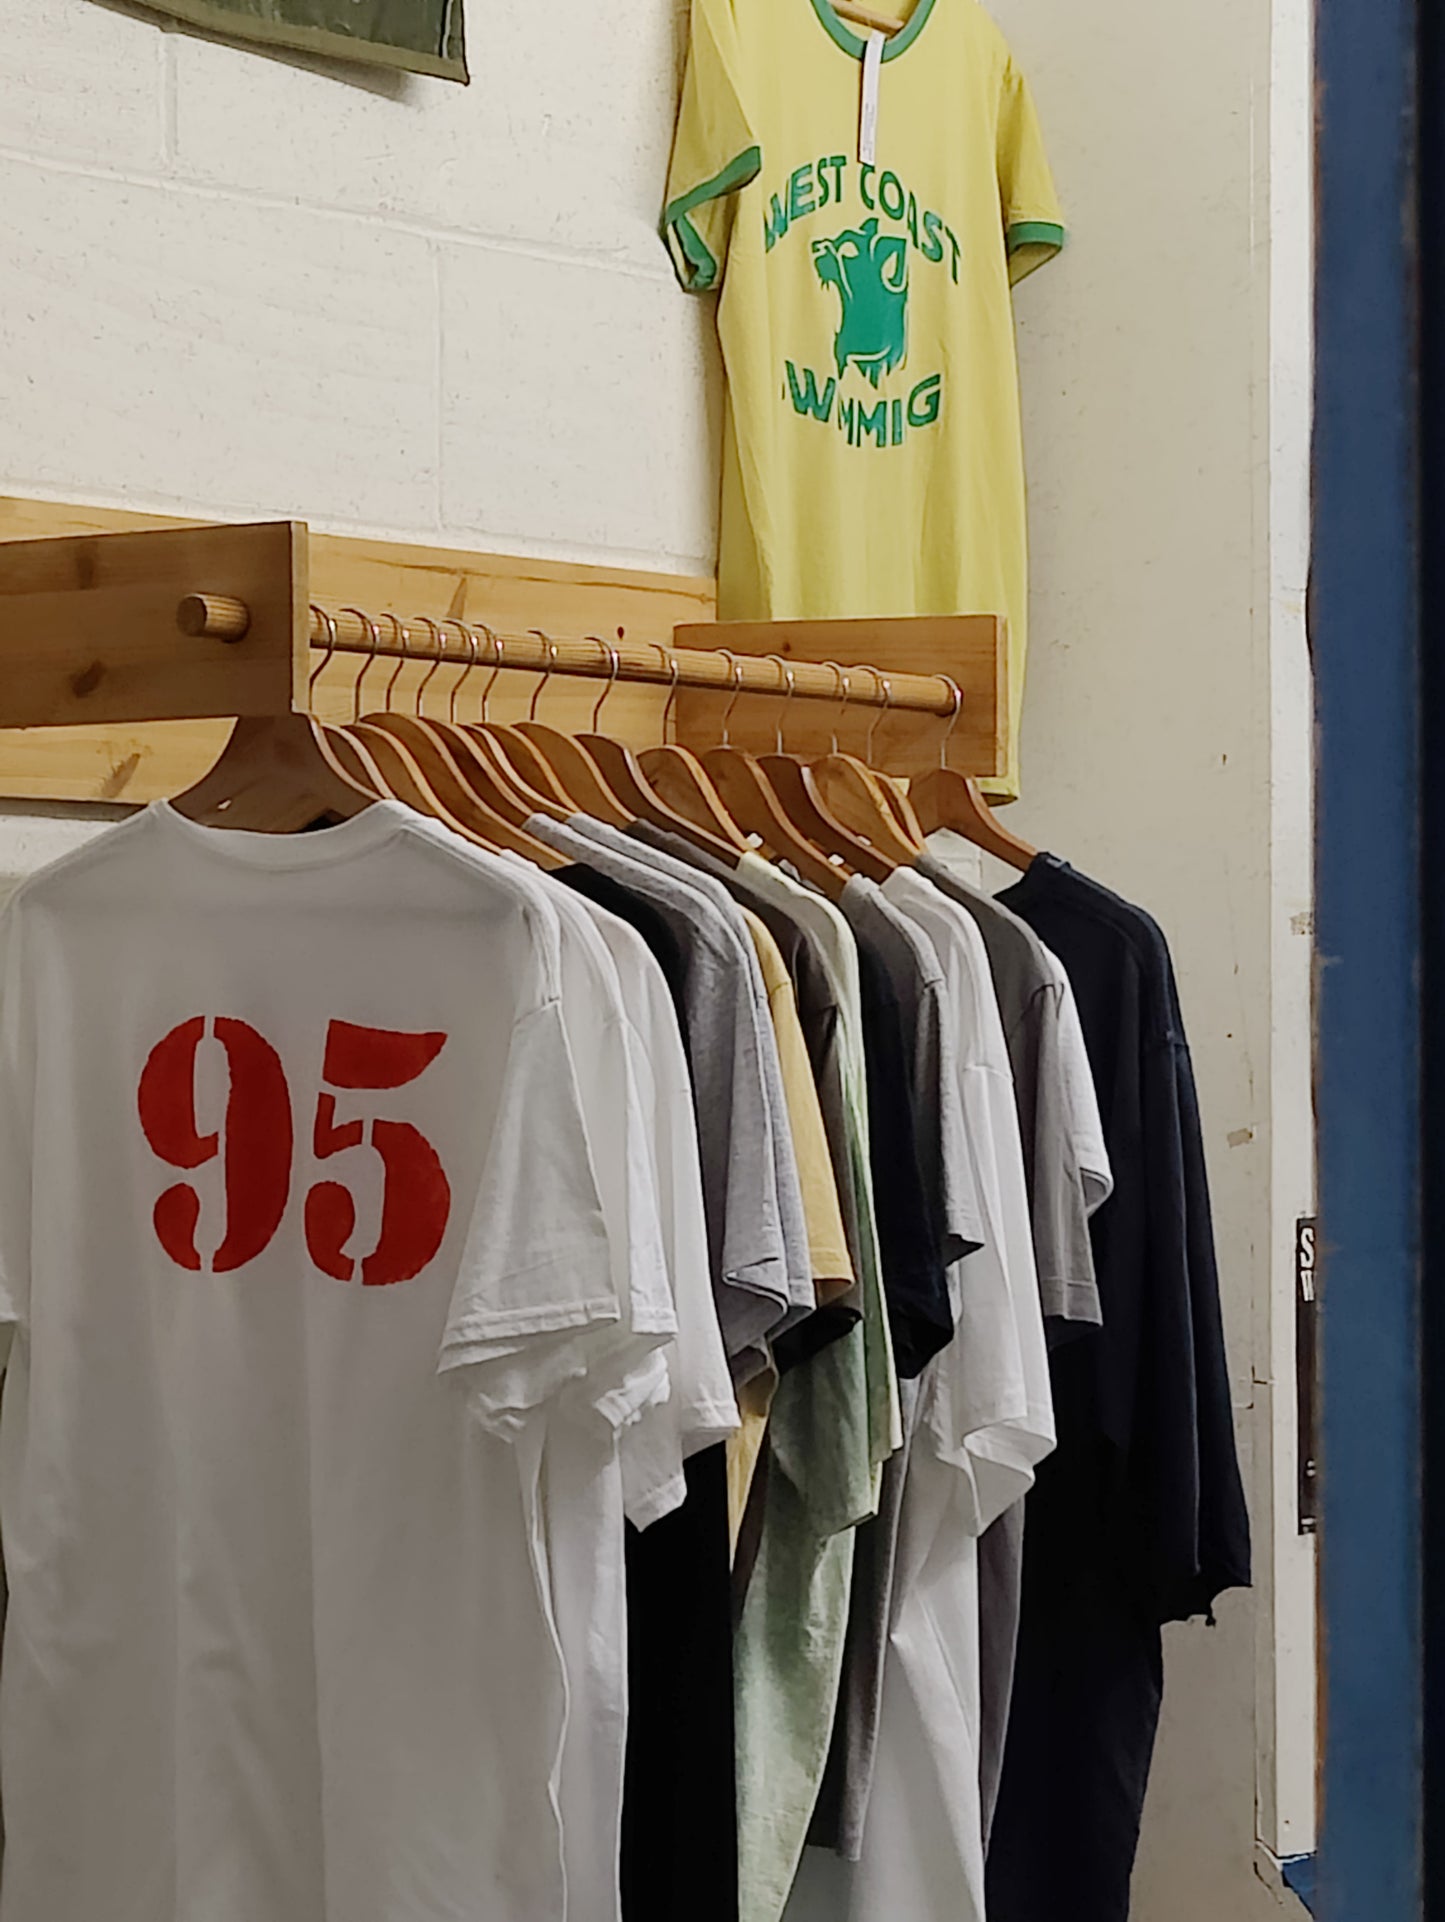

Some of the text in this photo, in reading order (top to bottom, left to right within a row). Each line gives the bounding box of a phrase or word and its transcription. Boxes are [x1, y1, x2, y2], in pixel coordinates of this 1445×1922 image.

[764, 155, 961, 285] WEST COAST
[137, 1015, 451, 1286] 95
